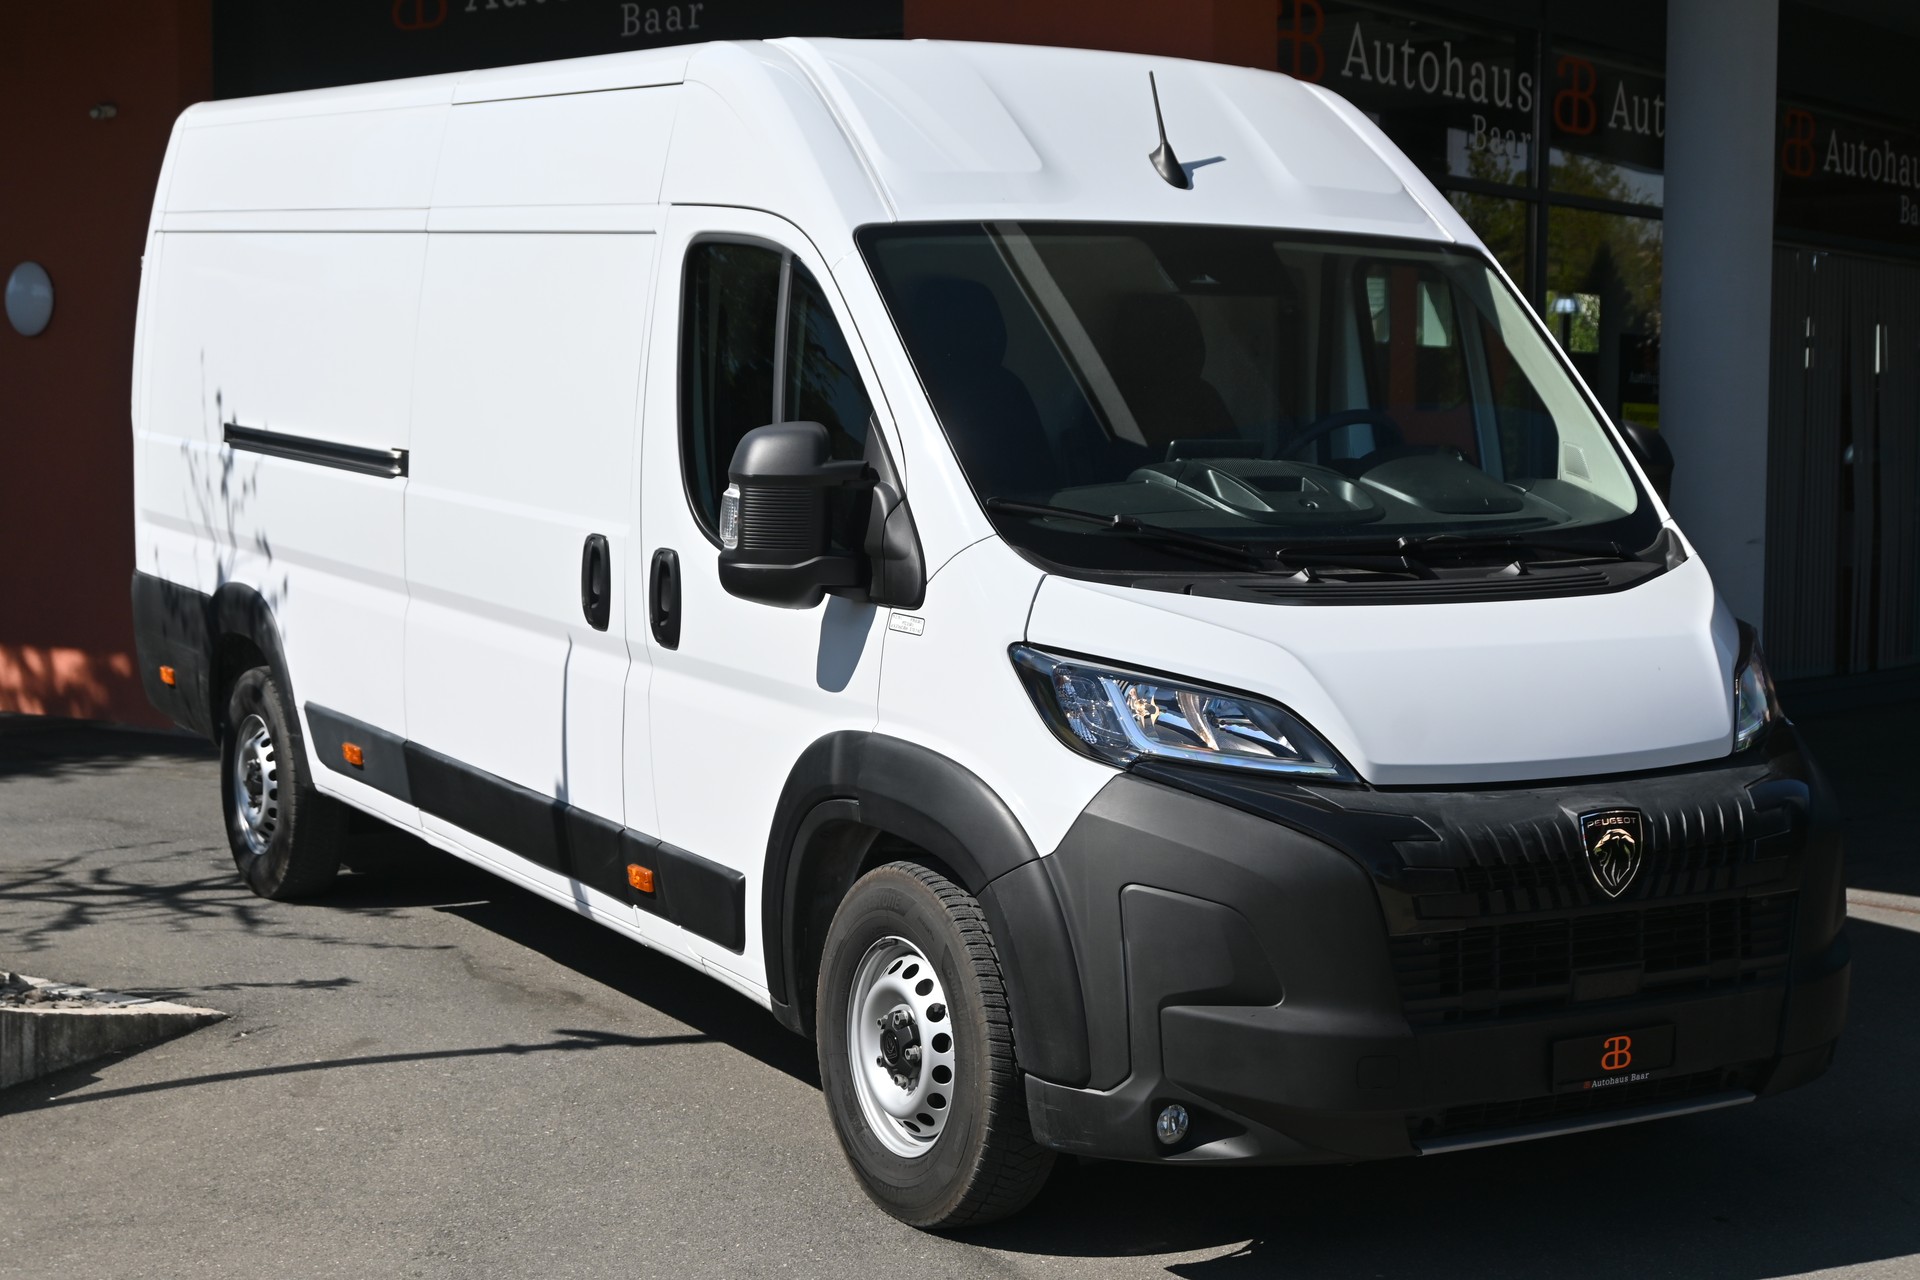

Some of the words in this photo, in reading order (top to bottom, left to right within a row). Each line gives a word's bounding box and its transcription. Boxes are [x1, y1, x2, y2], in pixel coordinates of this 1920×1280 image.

[620, 2, 703, 37] Baar
[1341, 21, 1533, 112] Autohaus
[1472, 114, 1532, 159] Baar
[1586, 816, 1637, 829] PEUGEOT
[1591, 1075, 1629, 1088] Autohaus
[1630, 1072, 1650, 1081] Baar
